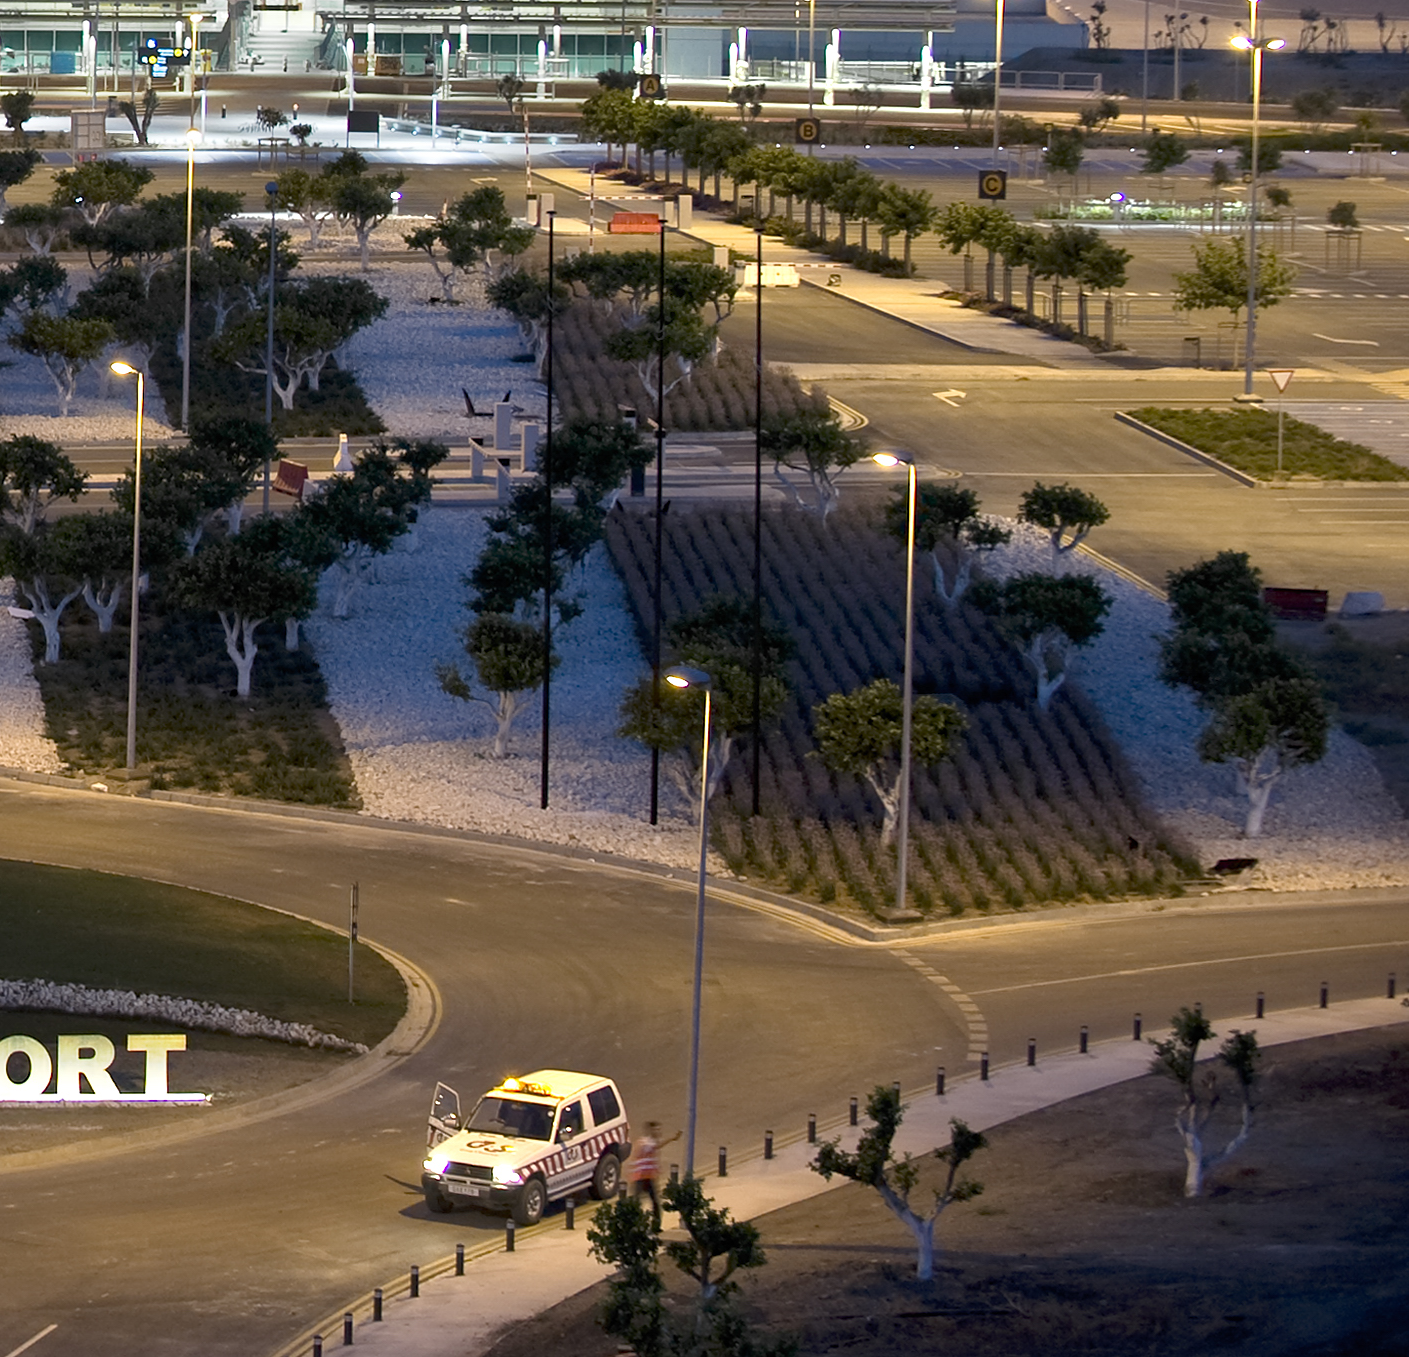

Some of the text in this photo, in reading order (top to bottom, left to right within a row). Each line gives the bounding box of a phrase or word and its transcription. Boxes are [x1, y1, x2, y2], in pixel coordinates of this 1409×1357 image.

[646, 79, 655, 91] A
[803, 124, 813, 137] B
[985, 177, 998, 191] C
